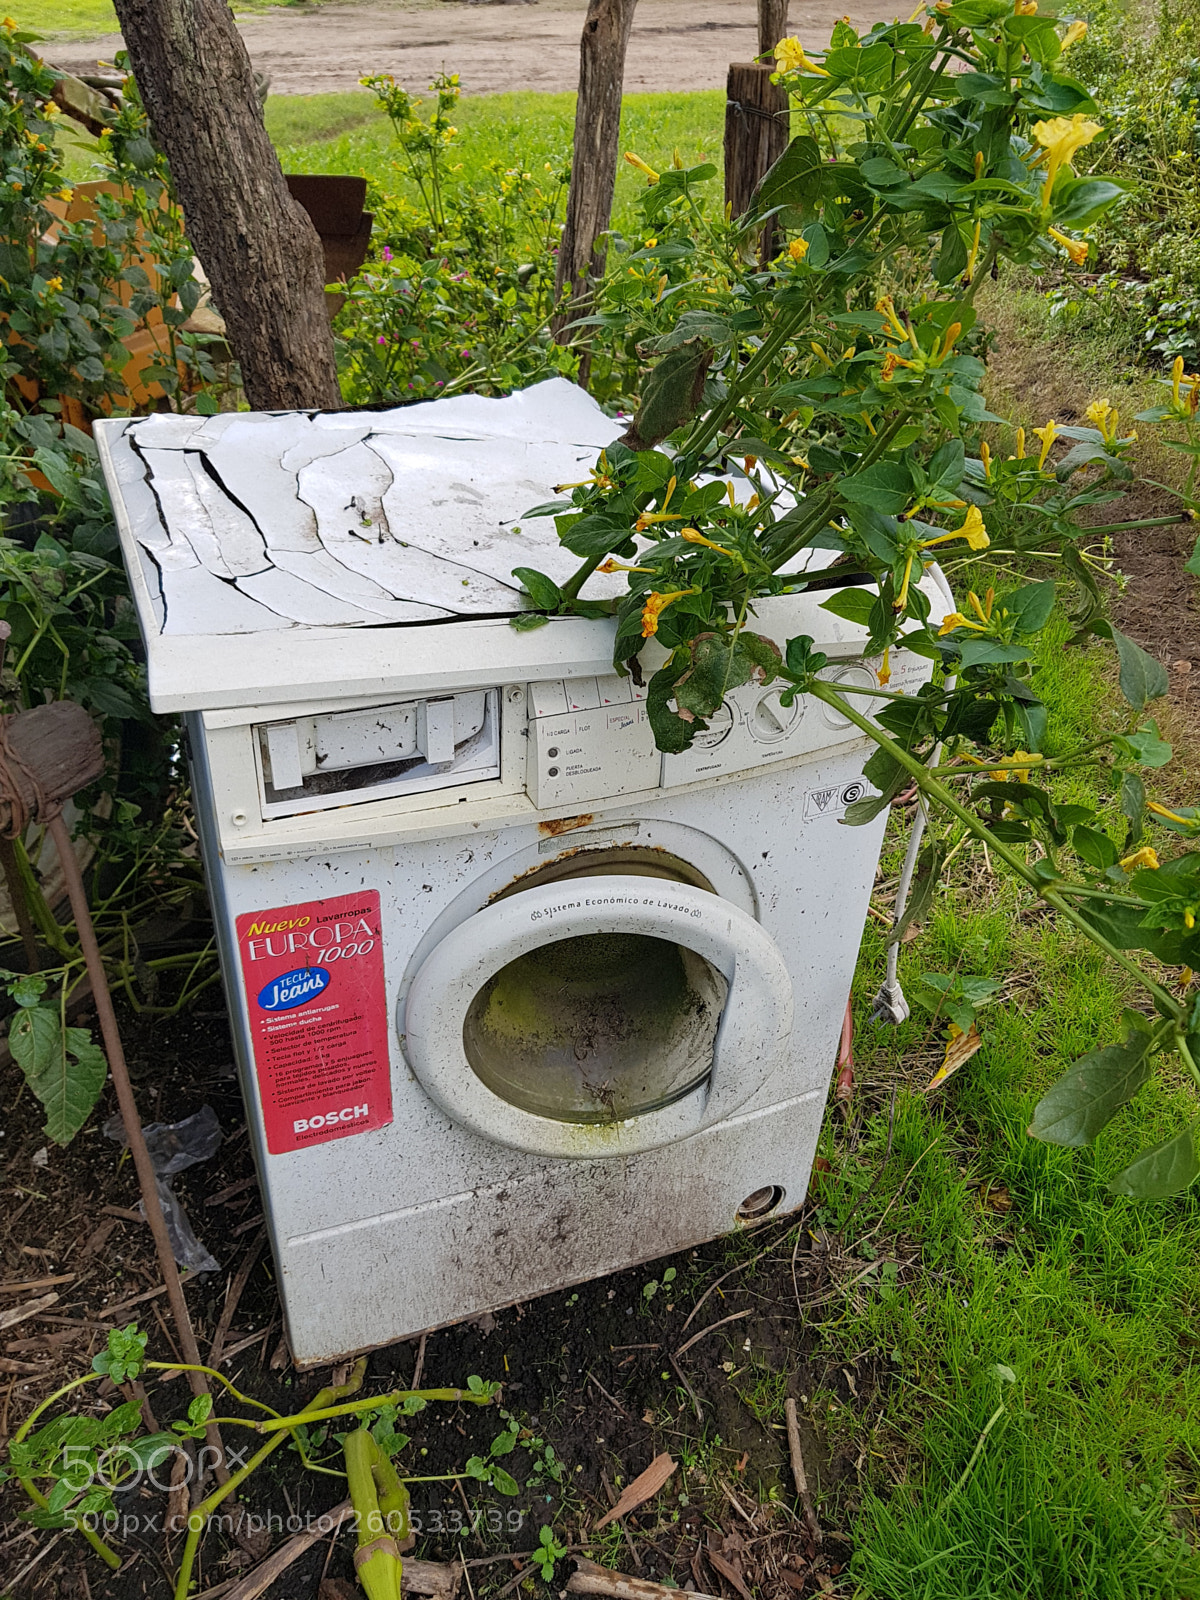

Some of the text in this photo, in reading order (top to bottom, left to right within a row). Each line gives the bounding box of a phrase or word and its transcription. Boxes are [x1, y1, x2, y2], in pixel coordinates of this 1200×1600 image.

[566, 767, 601, 776] DESBLOQUEADA
[544, 901, 581, 915] Sistema
[586, 897, 639, 906] Económico
[658, 900, 689, 913] Lavado
[248, 907, 372, 936] Nuevo Lavarropas
[249, 919, 373, 961] EUROPA
[317, 940, 374, 964] 1000
[280, 971, 311, 987] TECLA
[265, 974, 324, 1008] Jeans
[266, 1014, 296, 1024] Sistema
[299, 1016, 322, 1025] ducha
[269, 1028, 304, 1040] Velocidad
[271, 1044, 301, 1053] Selector
[314, 1031, 357, 1044] temperatura
[285, 1034, 305, 1042] hasta
[327, 1041, 347, 1049] carga
[273, 1057, 312, 1070] Capacidad:
[285, 1063, 324, 1075] programas
[312, 1068, 346, 1079] delicados
[353, 1060, 377, 1069] nuevos
[293, 1070, 316, 1079] tejidos
[277, 1086, 305, 1095] Sistema
[318, 1077, 341, 1085] lavado
[278, 1086, 334, 1103] Compartimiento
[279, 1096, 315, 1108] suavizante
[323, 1084, 364, 1097] blanqueador
[293, 1103, 369, 1133] BOSCH
